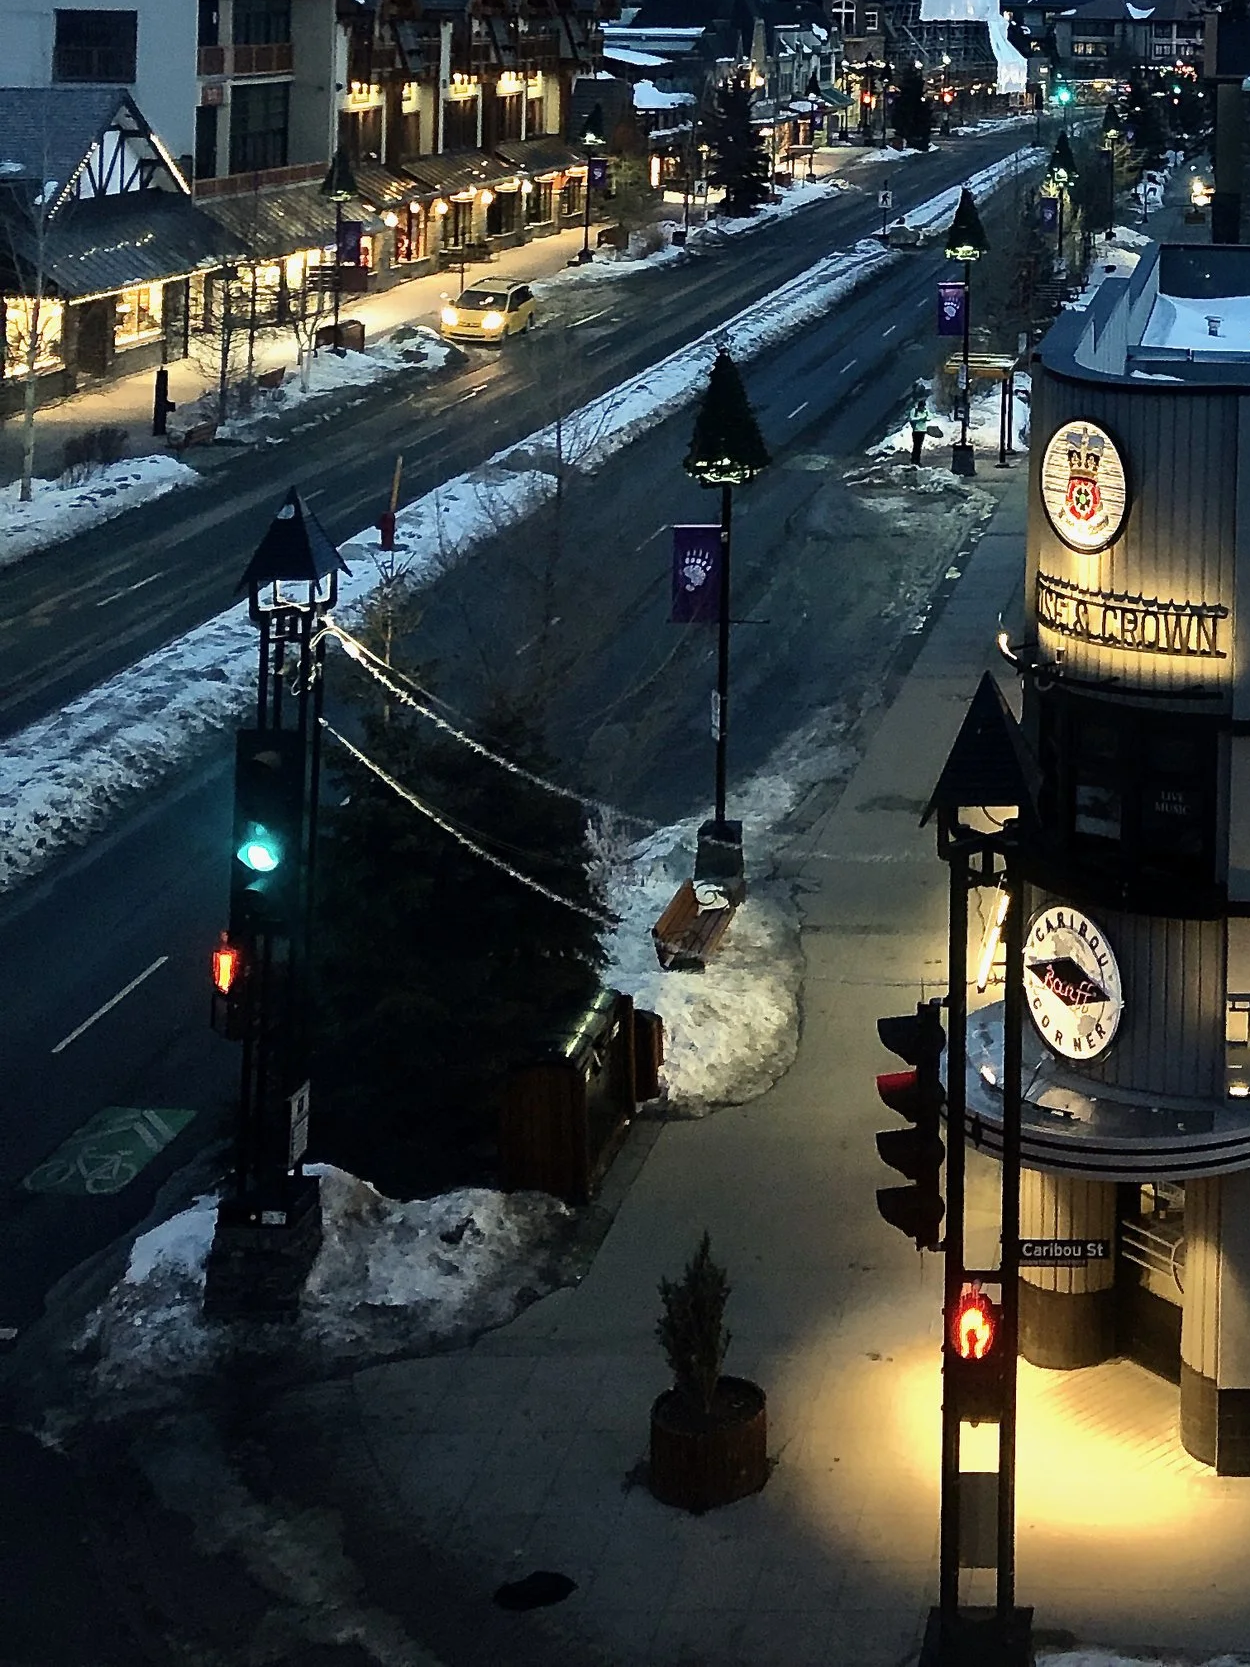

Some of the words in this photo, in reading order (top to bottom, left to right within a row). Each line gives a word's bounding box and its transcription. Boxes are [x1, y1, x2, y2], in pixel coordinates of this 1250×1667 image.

[1074, 601, 1089, 639] &
[1101, 605, 1218, 657] CROWN
[1154, 801, 1192, 816] MUSIC
[1161, 789, 1186, 803] LIVE
[1035, 911, 1109, 967] CARIBOU
[1044, 963, 1095, 1008] Banff
[1032, 997, 1107, 1052] CORNER
[1022, 1242, 1082, 1257] Caribou
[1086, 1242, 1104, 1257] St
